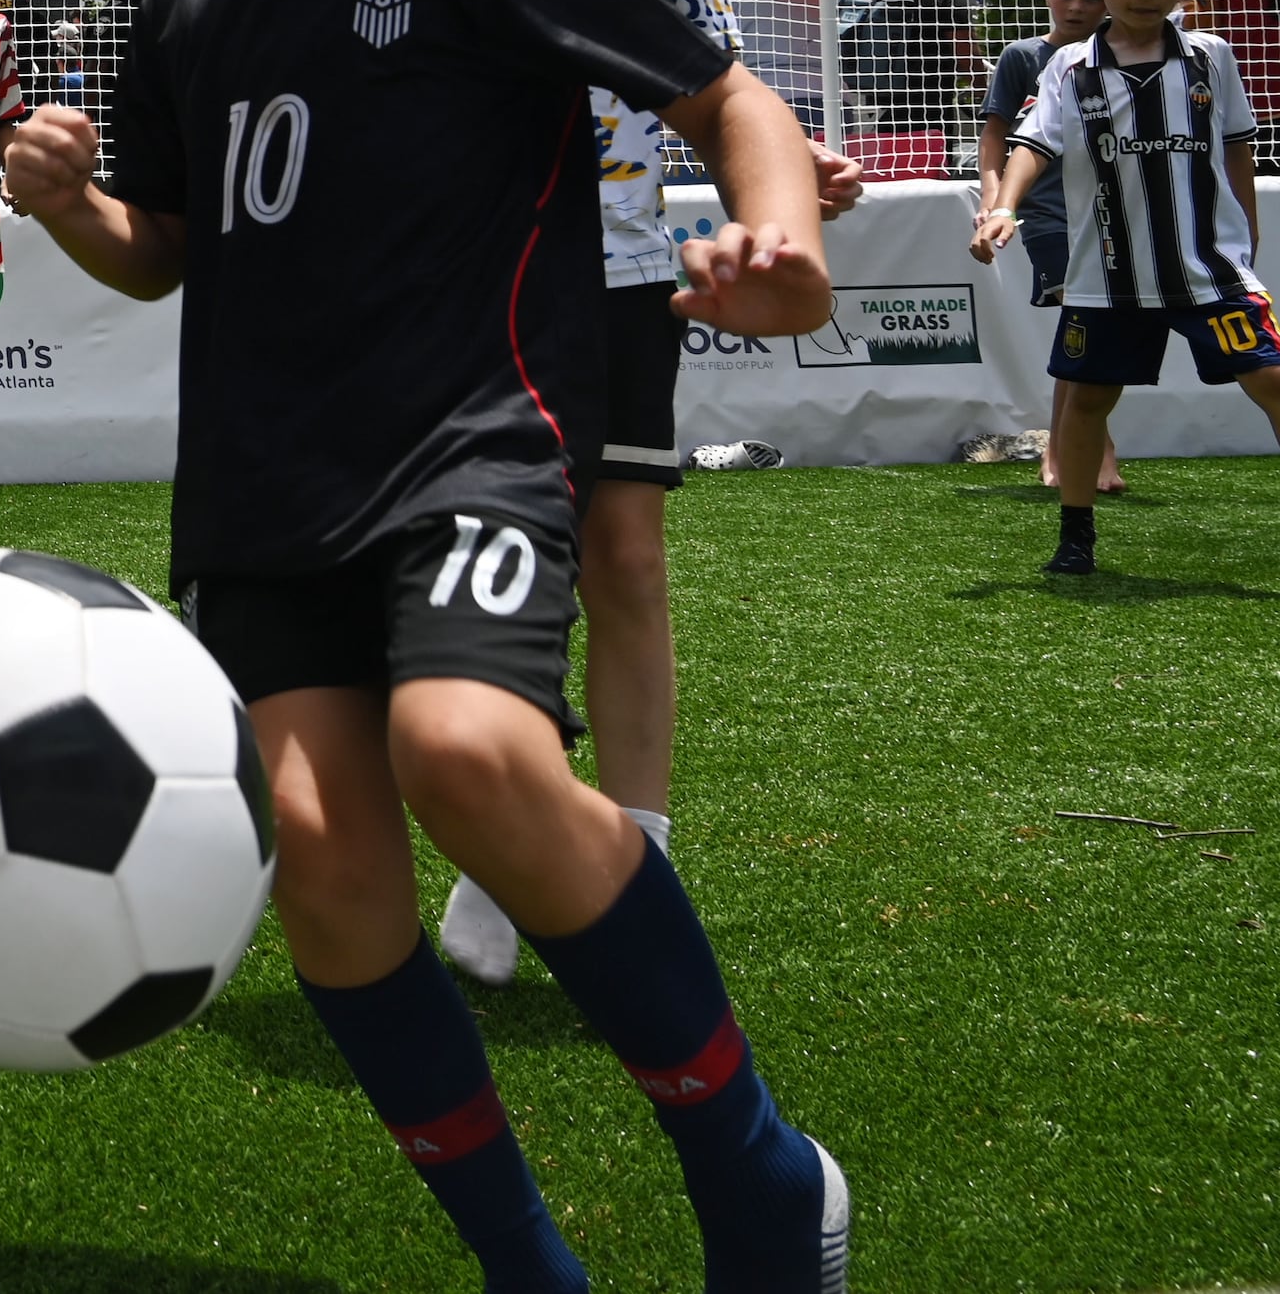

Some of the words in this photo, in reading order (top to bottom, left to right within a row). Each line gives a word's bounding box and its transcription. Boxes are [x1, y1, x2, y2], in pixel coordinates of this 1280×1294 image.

[1121, 136, 1208, 154] LayerZero
[221, 93, 310, 234] 10
[861, 300, 915, 313] TAILOR
[921, 299, 967, 312] MADE
[881, 314, 950, 331] GRASS
[1207, 311, 1258, 355] 10
[681, 326, 772, 354] OCK
[688, 362, 706, 370] THE
[708, 361, 733, 370] FIELD
[735, 361, 749, 370] OF
[751, 361, 774, 370] PLAY
[429, 514, 536, 616] 10
